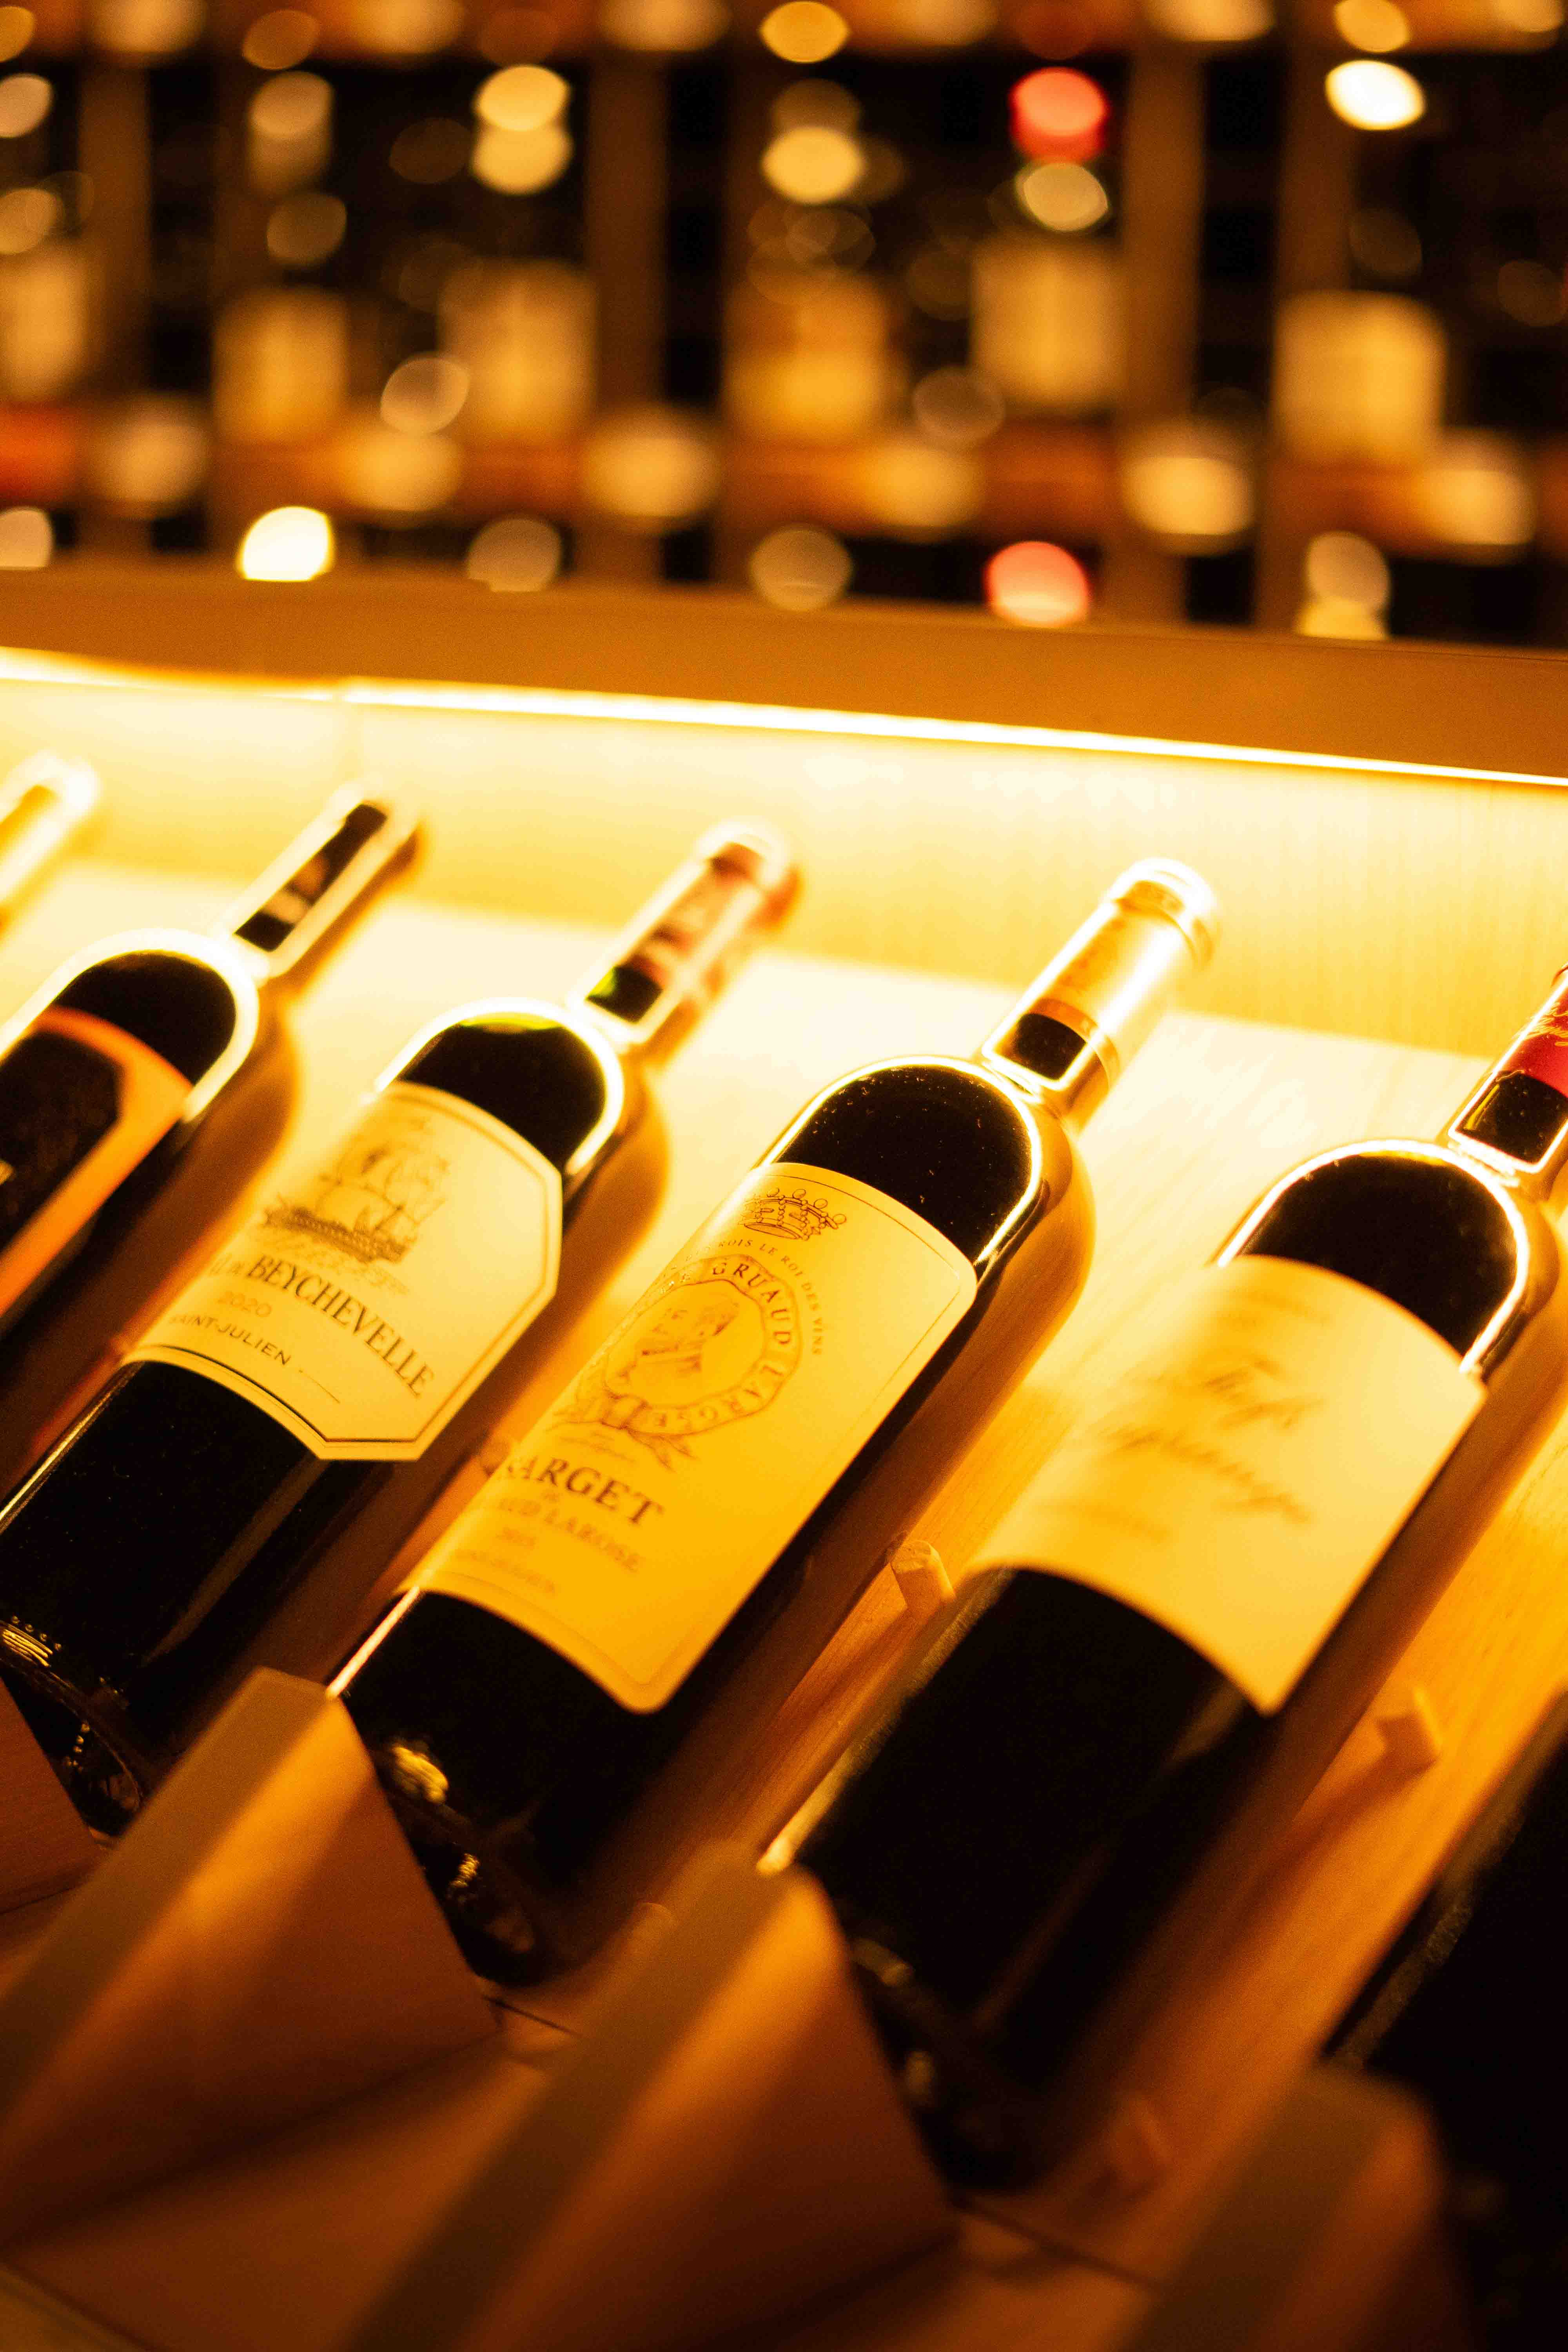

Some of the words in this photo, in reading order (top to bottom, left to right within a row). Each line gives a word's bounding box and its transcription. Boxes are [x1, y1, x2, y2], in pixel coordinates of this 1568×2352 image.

[759, 1243, 778, 1255] LE
[781, 1255, 803, 1277] ROI
[218, 1292, 272, 1318] 2020
[246, 1254, 434, 1398] BEYCHEVELLE
[712, 1262, 792, 1345] GRUAUD
